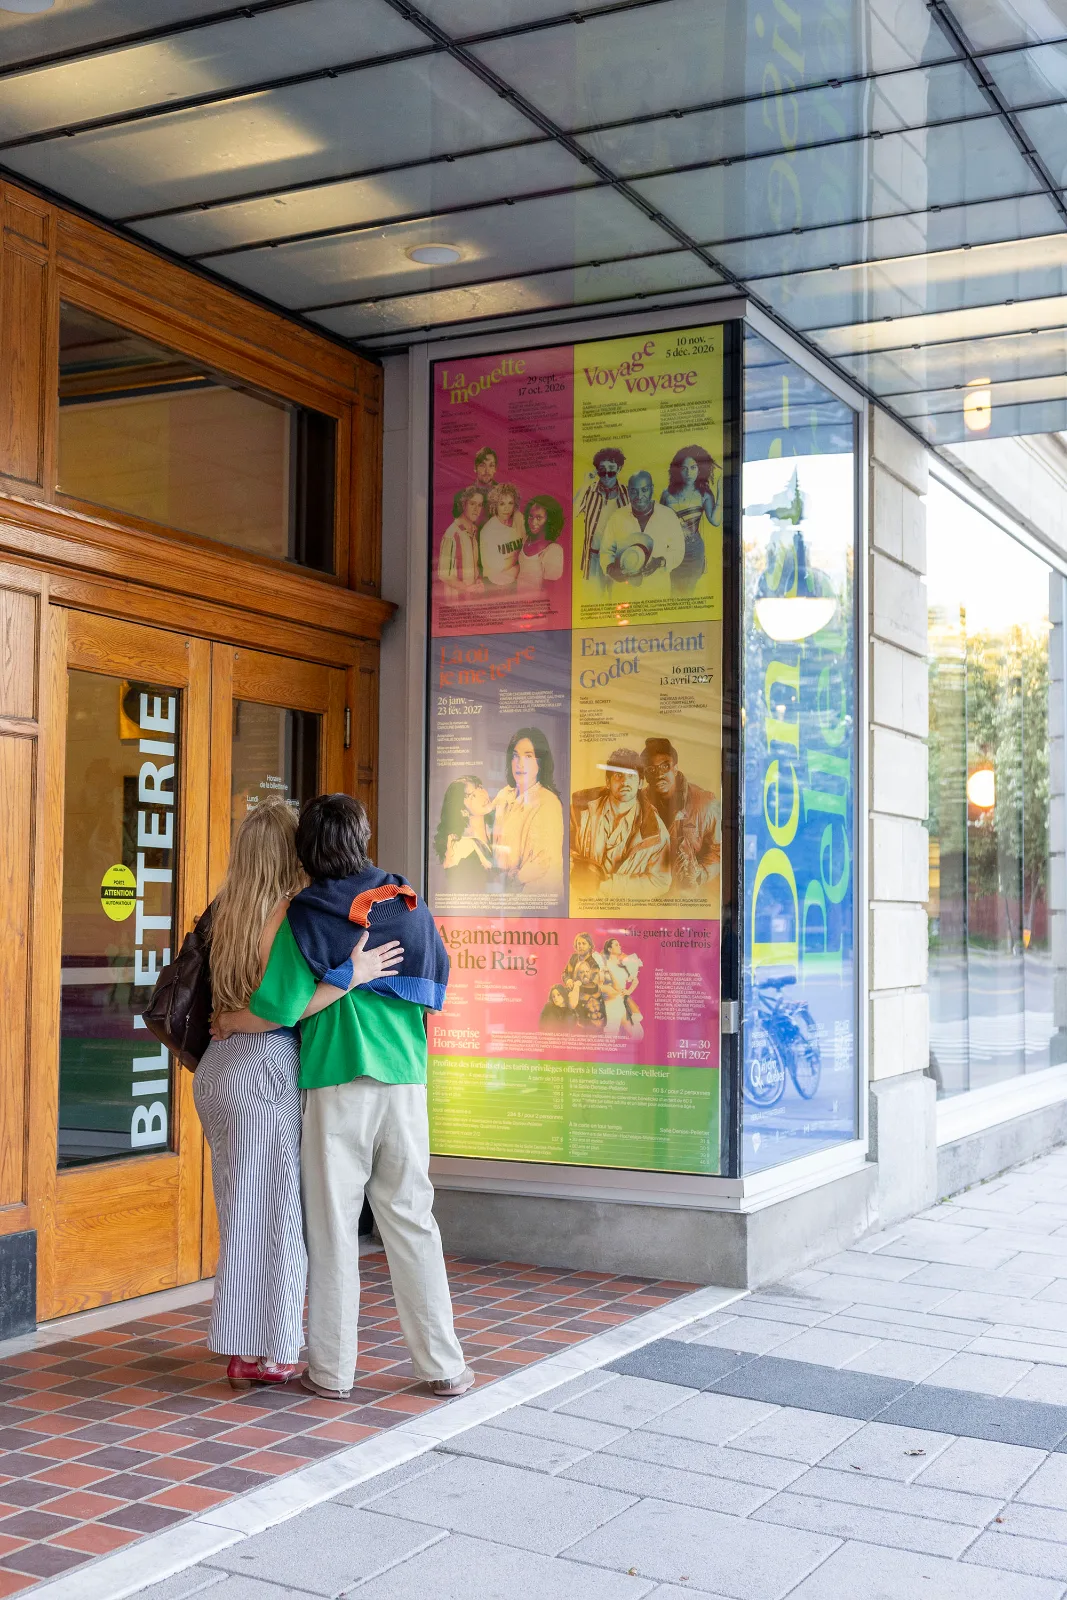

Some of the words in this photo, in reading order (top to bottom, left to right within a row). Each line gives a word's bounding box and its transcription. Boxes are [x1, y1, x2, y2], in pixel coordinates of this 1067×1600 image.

[677, 337, 686, 346] 10
[688, 336, 706, 345] nov.
[665, 349, 671, 358] 5
[672, 347, 691, 357] déc.
[692, 344, 715, 355] 2026
[583, 340, 655, 390] Voyage
[441, 370, 466, 390] La
[449, 357, 526, 404] mouette
[625, 370, 698, 396] voyage
[518, 386, 527, 396] 17
[528, 385, 543, 395] oct.
[544, 383, 566, 392] 2026
[580, 637, 608, 657] En
[613, 630, 705, 655] attendant
[441, 643, 463, 666] Là
[465, 642, 489, 663] où
[439, 665, 455, 689] je
[458, 668, 487, 685] me
[489, 645, 536, 681] terre
[579, 656, 640, 689] Godot
[671, 665, 681, 674] 16
[683, 666, 705, 674] mars
[660, 677, 669, 686] 13
[670, 675, 690, 685] avril
[691, 674, 714, 684] 2027
[437, 696, 448, 706] 26
[448, 695, 467, 706] janv.
[437, 706, 448, 716] 23
[448, 705, 462, 716] fév.
[463, 705, 483, 715] 2027
[104, 888, 134, 897] ATTENTION
[439, 924, 559, 949] Agamemnon
[673, 928, 683, 938] de
[660, 940, 690, 948] contre
[690, 940, 711, 948] trois
[457, 949, 487, 969] the
[491, 949, 538, 976] Ring
[433, 1027, 447, 1037] En
[447, 1028, 480, 1039] reprise
[433, 1038, 481, 1049] Hors-série
[679, 1038, 689, 1048] 21
[698, 1040, 711, 1049] 30
[667, 1049, 687, 1059] avril
[689, 1051, 711, 1060] 2027
[433, 1060, 457, 1068] Profitez
[459, 1060, 470, 1068] des
[513, 1062, 530, 1070] tarifs
[530, 1063, 562, 1073] privilèges
[563, 1065, 585, 1074] offerts
[599, 1067, 615, 1076] Salle
[617, 1068, 671, 1078] Denise-Pelletier
